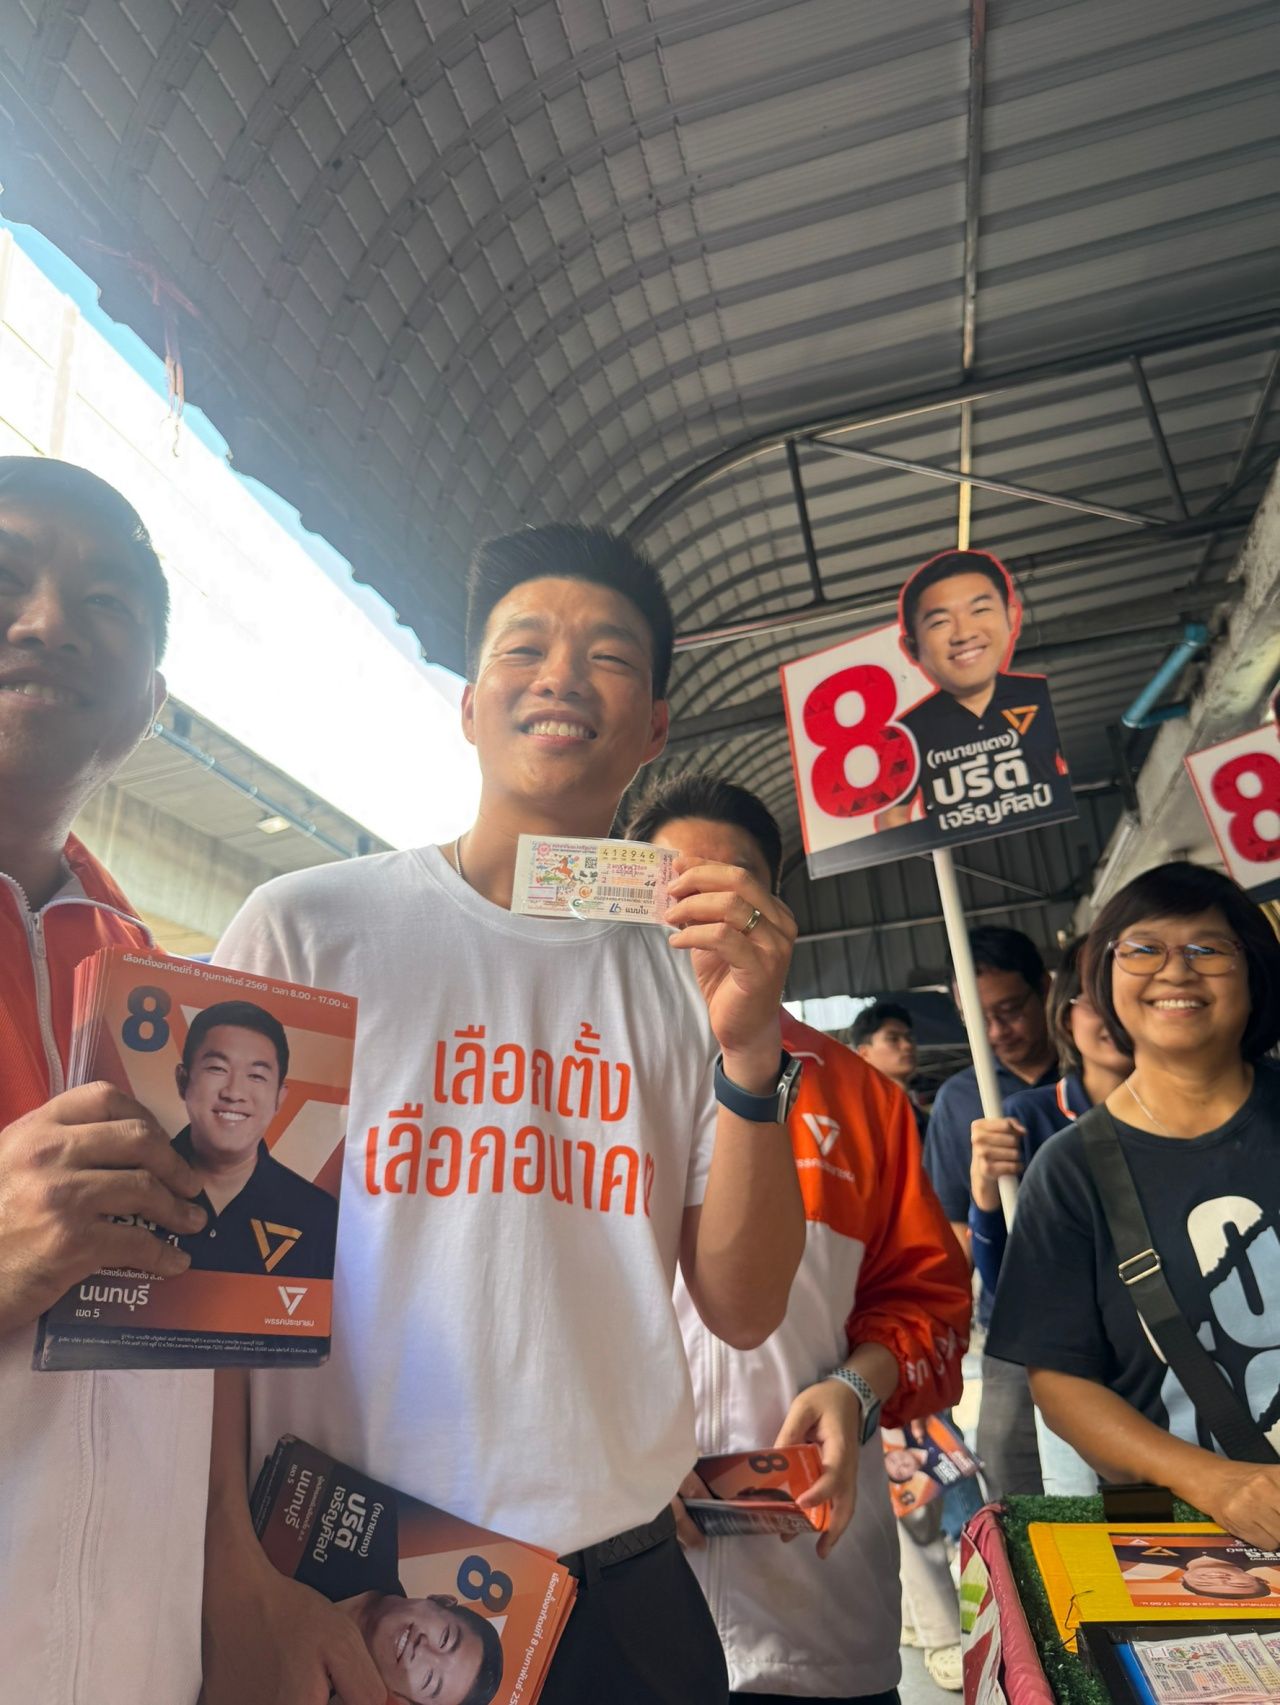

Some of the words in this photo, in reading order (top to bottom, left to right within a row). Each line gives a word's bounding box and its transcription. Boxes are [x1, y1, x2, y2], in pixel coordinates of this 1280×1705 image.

[803, 664, 916, 818] 8
[927, 728, 1019, 768] (ทนายแดง)
[932, 748, 1030, 805] ปรีติ
[938, 782, 1053, 831] เจริญศิลป์
[1210, 752, 1280, 864] 8
[194, 968, 201, 977] 8
[246, 979, 268, 991] 2569
[290, 990, 311, 1000] 8.00
[318, 995, 341, 1007] 17.00
[121, 984, 172, 1053] 8
[433, 1022, 632, 1123] เลือกตั้ง
[75, 1308, 91, 1318] เขต
[93, 1308, 100, 1318] 5
[79, 1283, 151, 1312] นนทบุรี
[748, 1452, 789, 1474] 8
[283, 1469, 313, 1530] นนทบุรี
[312, 1486, 346, 1563] เจริญศิลป์
[334, 1493, 367, 1552] ปรีติ
[357, 1502, 385, 1557] (ทนายแดง)
[457, 1555, 513, 1613] 8
[515, 1646, 535, 1692] กุมภาพันธ์
